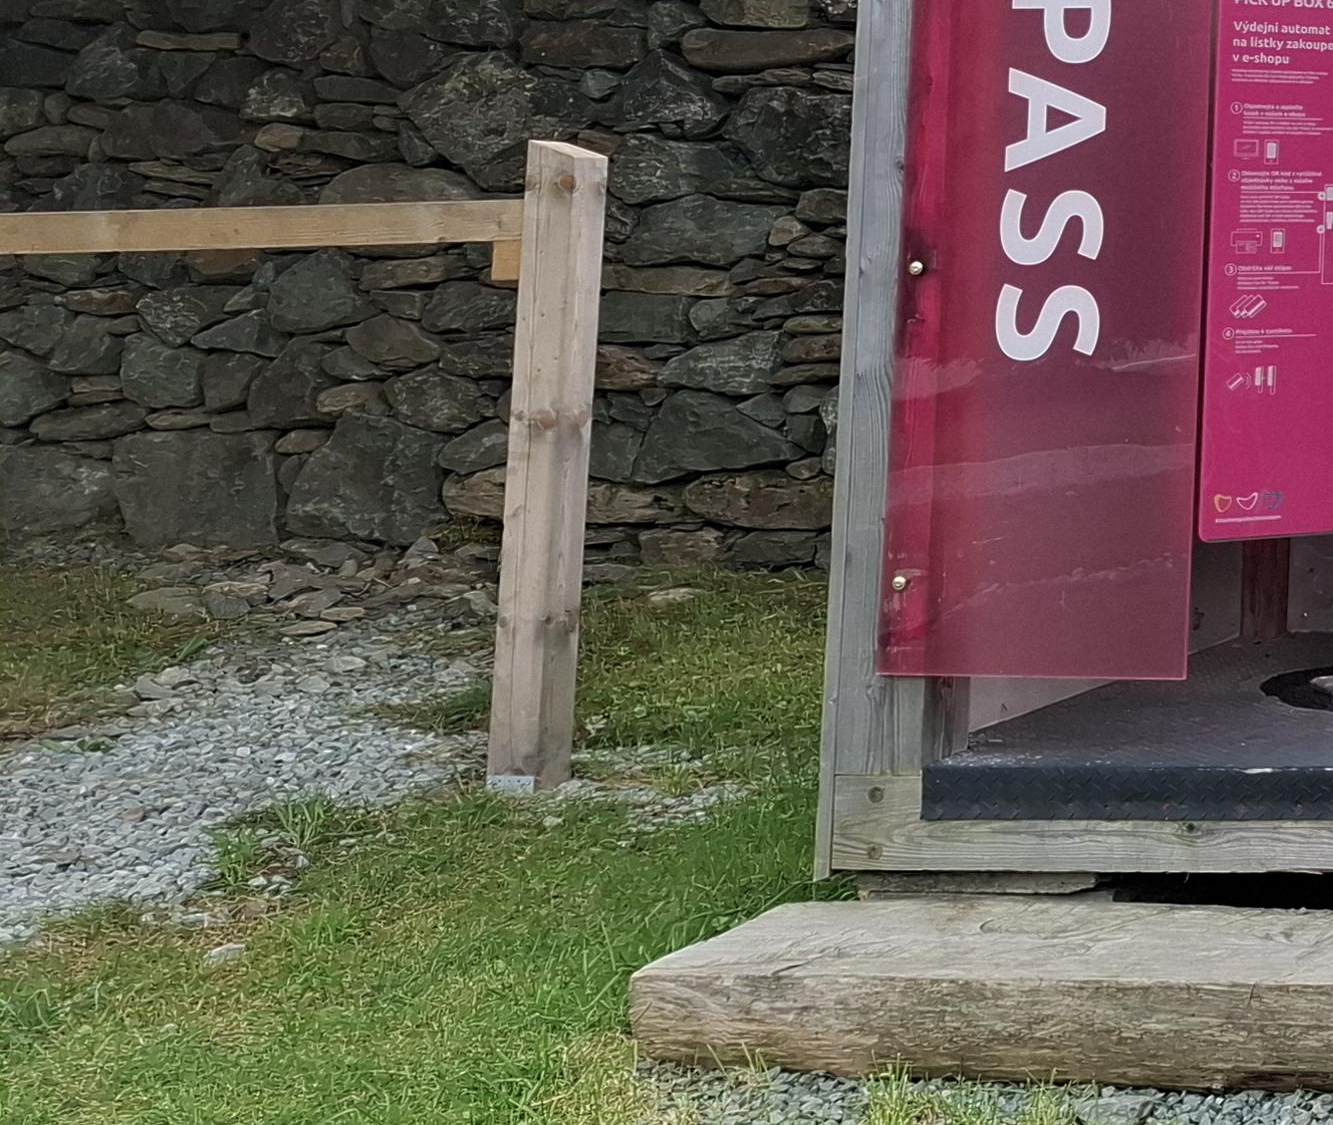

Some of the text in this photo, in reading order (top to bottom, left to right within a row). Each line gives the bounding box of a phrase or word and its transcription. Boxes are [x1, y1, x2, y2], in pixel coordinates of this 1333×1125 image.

[1281, 23, 1331, 36] automat
[1232, 38, 1247, 47] na
[1232, 52, 1290, 66] v e-shopu
